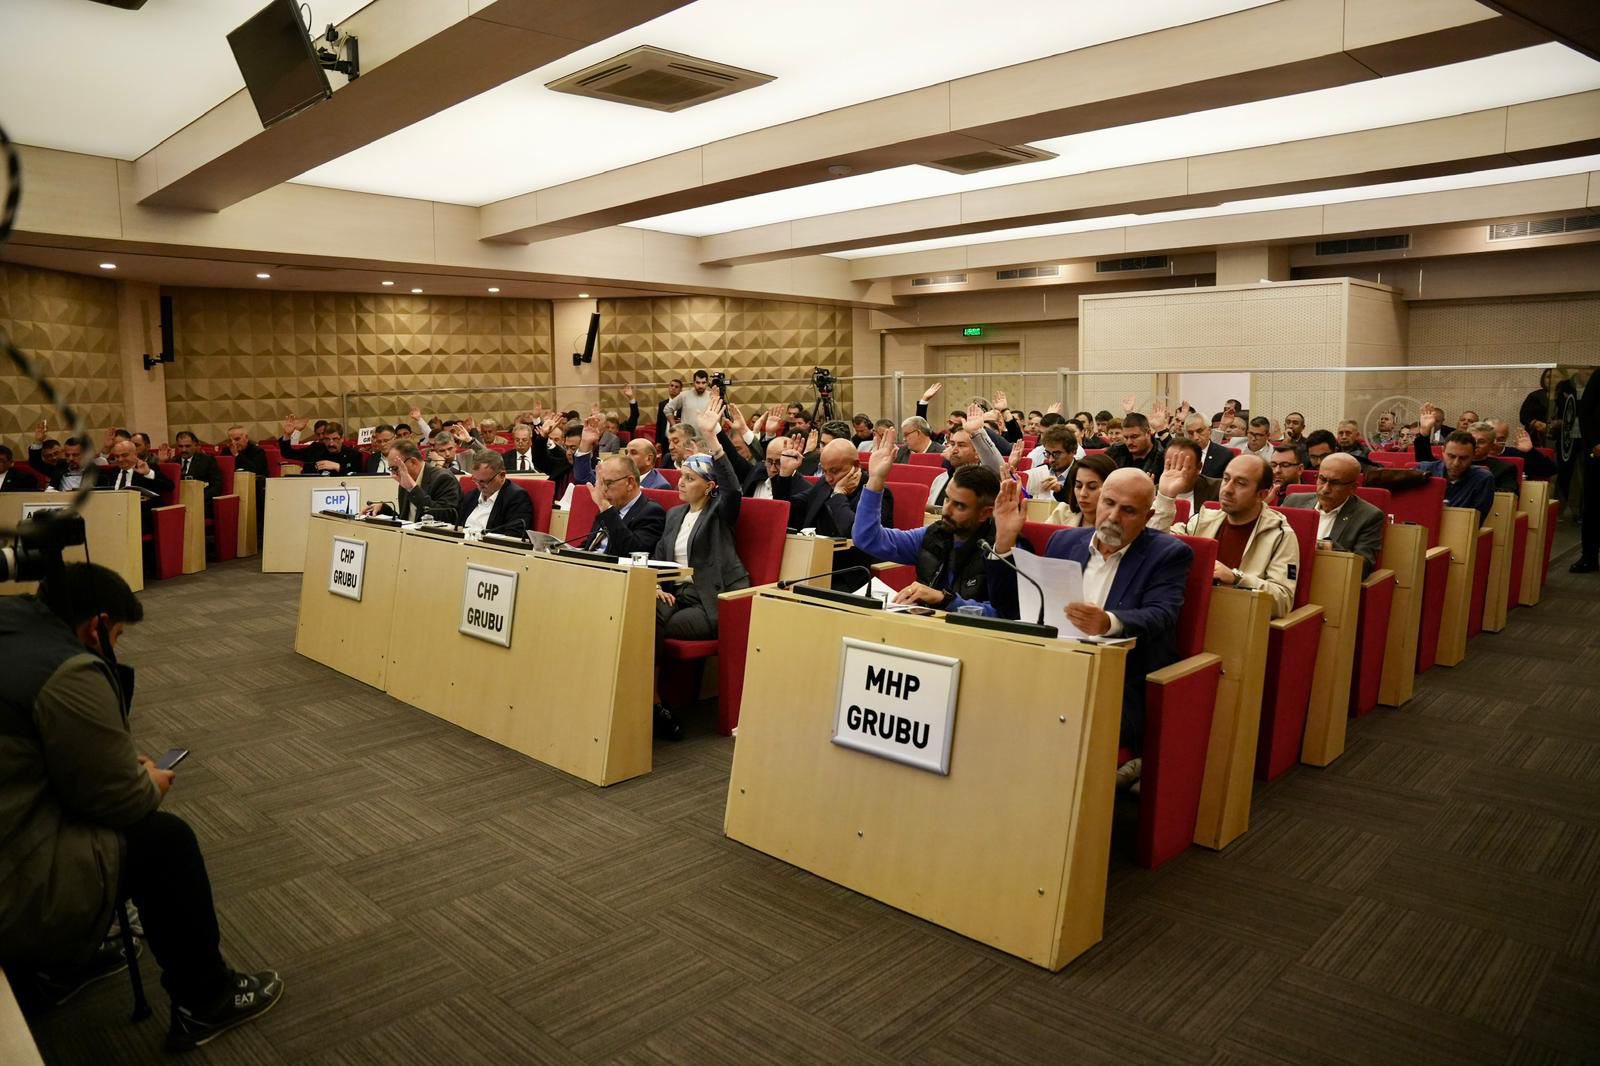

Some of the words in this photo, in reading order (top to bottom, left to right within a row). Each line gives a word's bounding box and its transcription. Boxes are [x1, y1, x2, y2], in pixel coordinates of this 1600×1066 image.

[325, 495, 346, 505] CHP
[340, 548, 355, 564] CHP
[333, 569, 358, 588] GRUBU
[477, 581, 499, 601] CHP
[467, 607, 504, 632] GRUBU
[865, 665, 920, 700] MHP
[847, 705, 930, 749] GRUBU
[234, 991, 255, 1006] EA7
